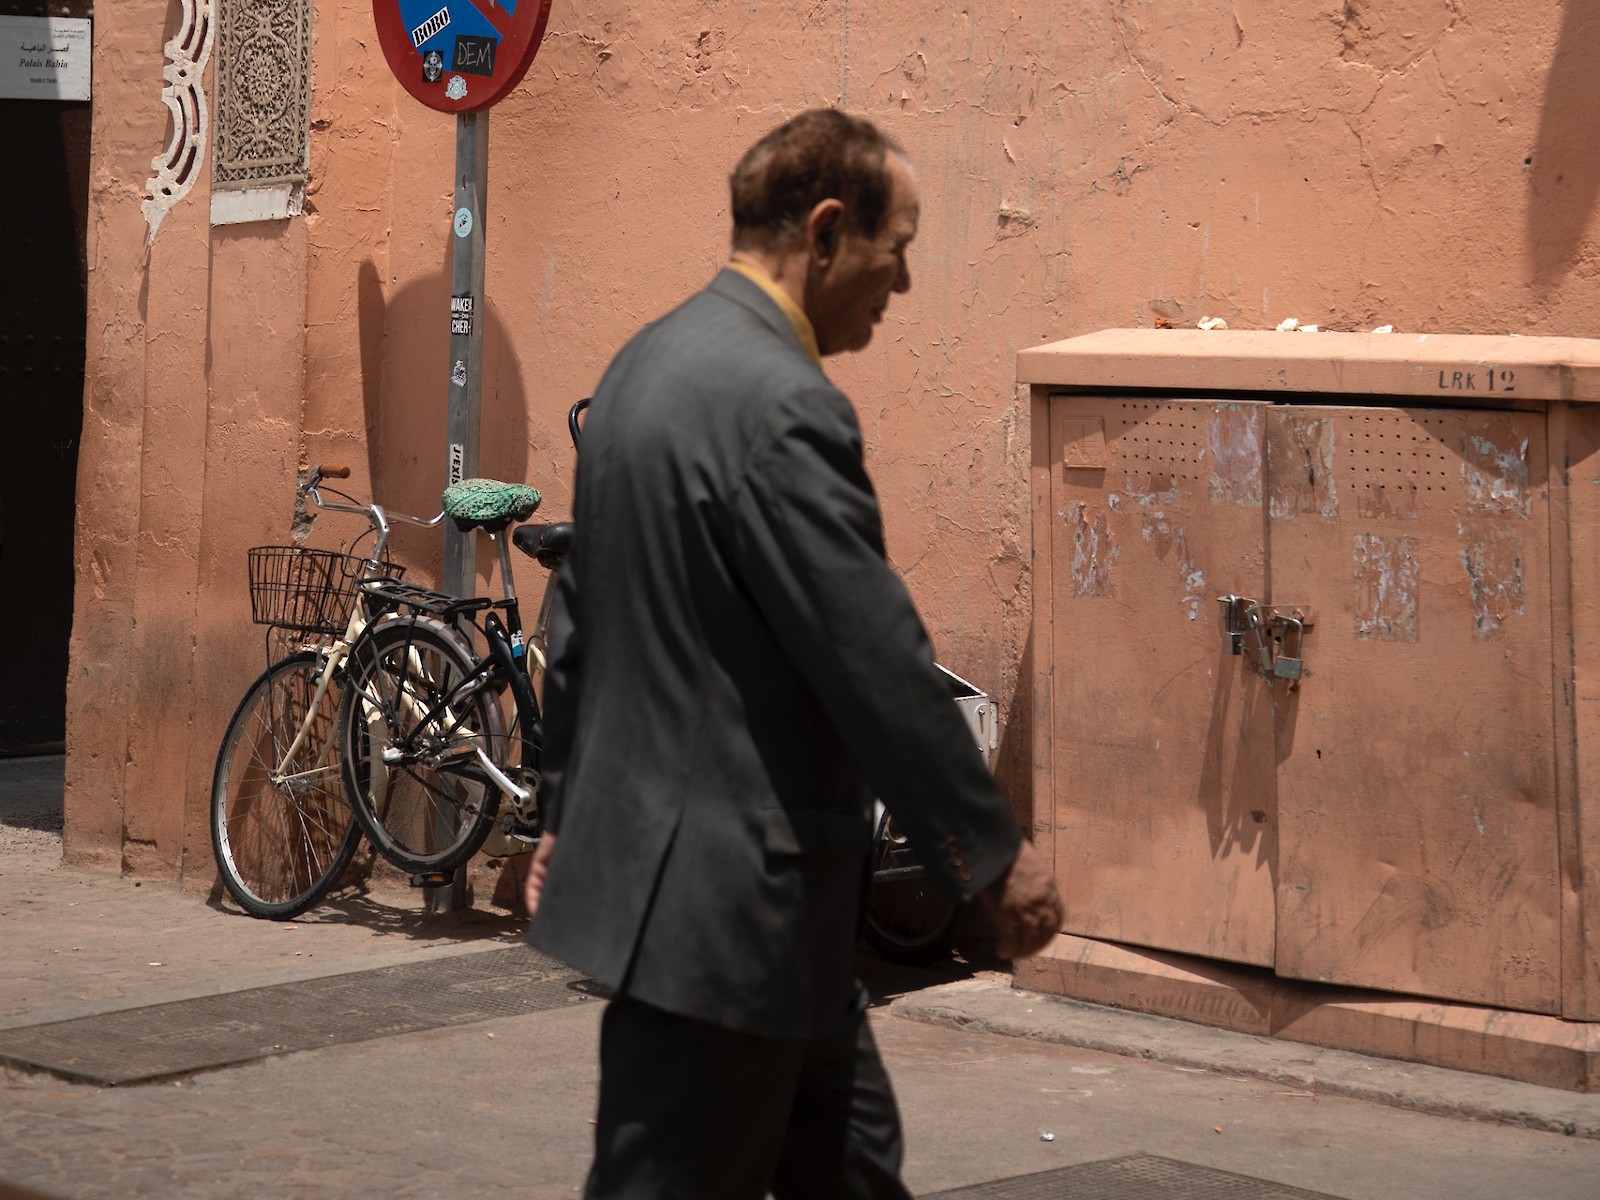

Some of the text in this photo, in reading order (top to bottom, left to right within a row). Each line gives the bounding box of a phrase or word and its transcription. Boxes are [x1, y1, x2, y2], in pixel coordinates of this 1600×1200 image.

[412, 9, 449, 46] BOBO
[19, 59, 68, 68] Palais Bahia
[457, 42, 492, 70] DEM
[1439, 368, 1515, 392] LRK 12
